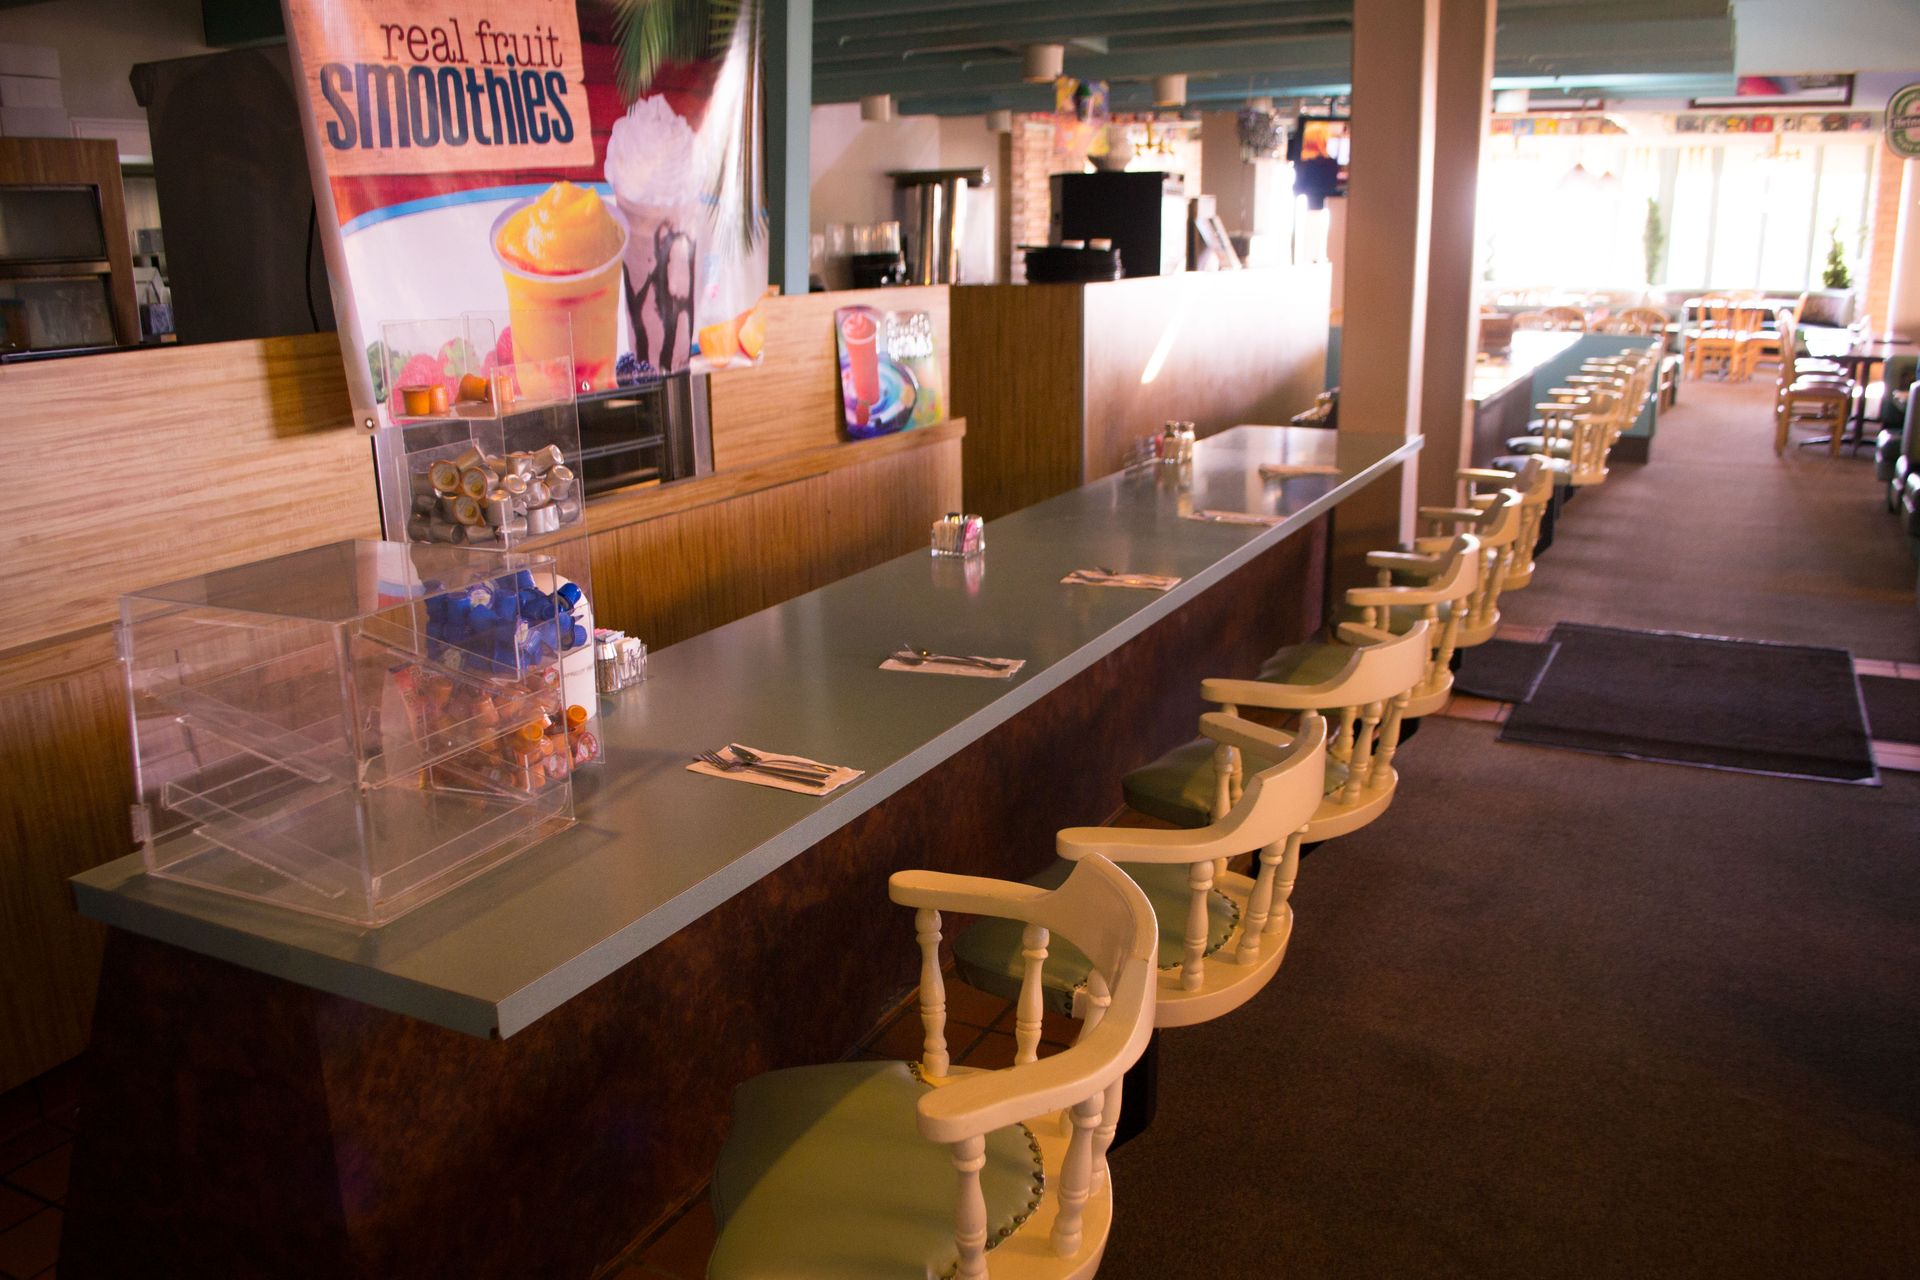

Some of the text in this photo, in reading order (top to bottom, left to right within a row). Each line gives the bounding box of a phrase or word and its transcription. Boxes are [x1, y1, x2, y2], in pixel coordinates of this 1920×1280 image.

[380, 17, 563, 68] real fruit
[320, 53, 574, 150] smoothies
